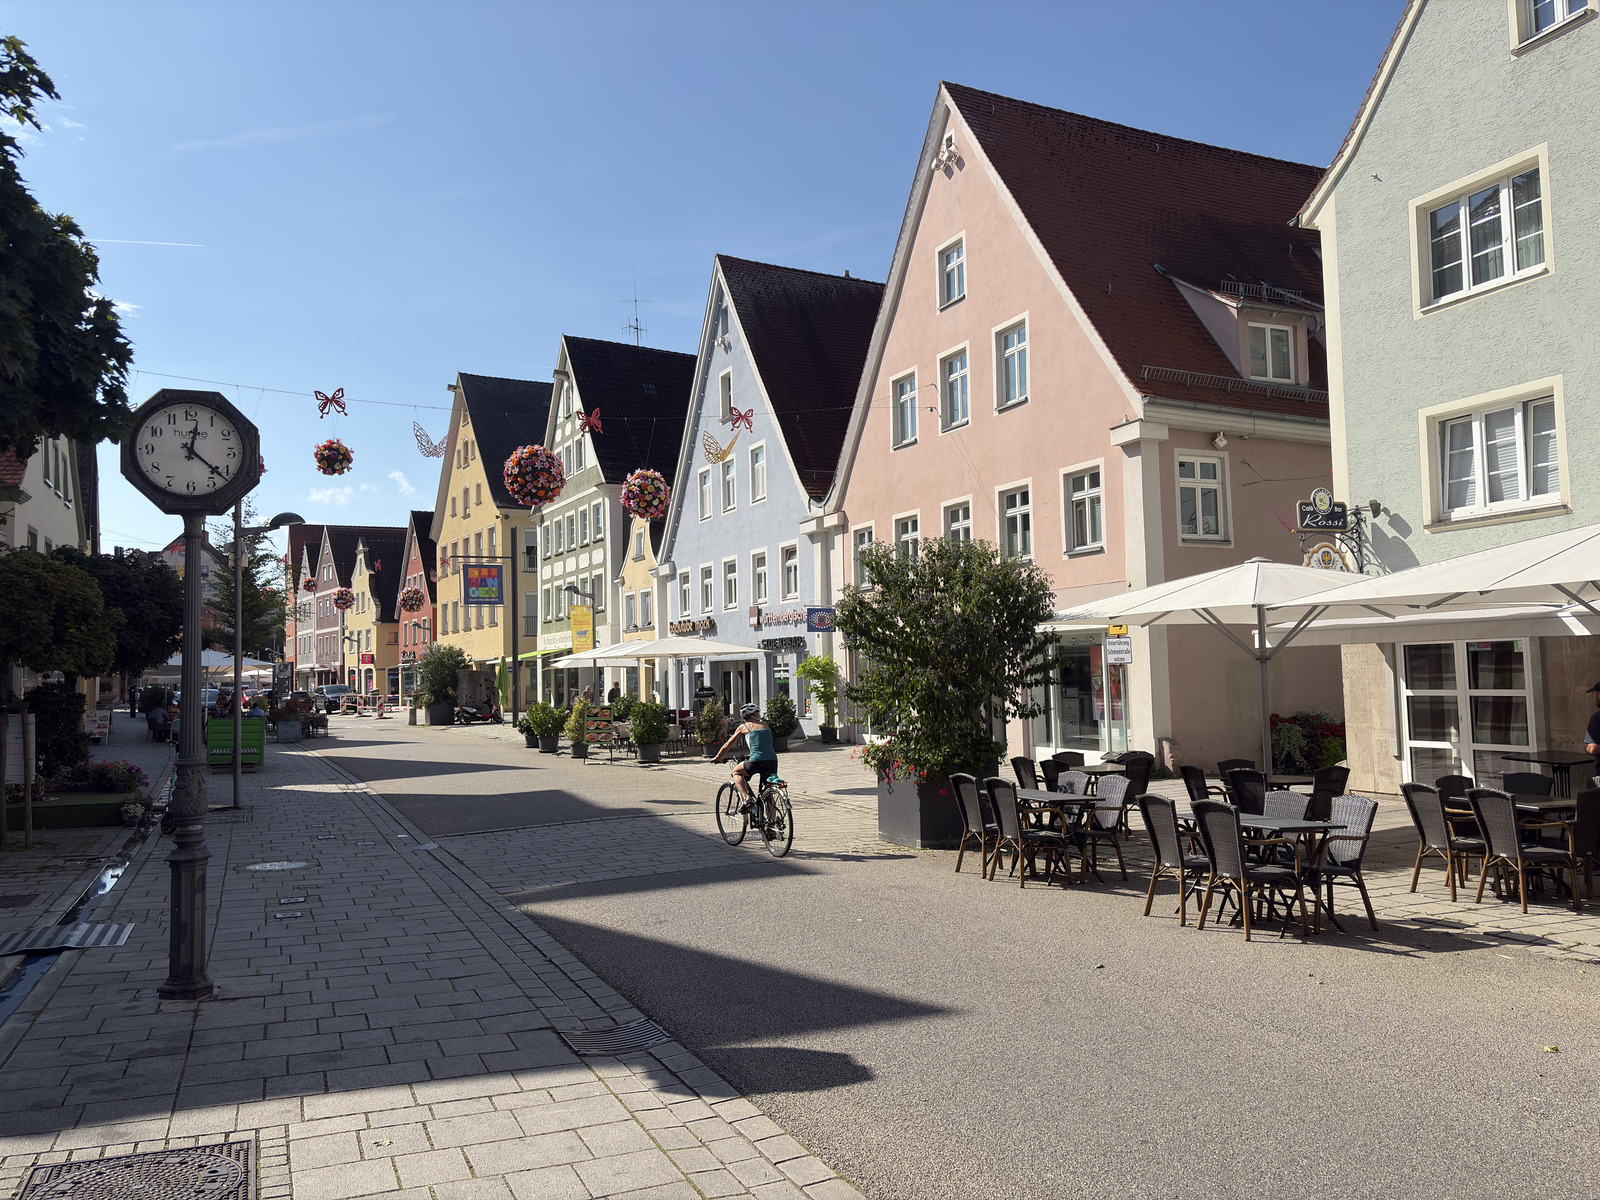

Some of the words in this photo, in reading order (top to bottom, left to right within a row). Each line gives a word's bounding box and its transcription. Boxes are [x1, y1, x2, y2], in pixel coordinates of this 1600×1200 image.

[167, 414, 176, 425] 11
[184, 410, 198, 421] 12
[208, 415, 214, 427] 1
[150, 426, 163, 438] 10
[221, 429, 231, 441] 2
[145, 443, 155, 455] 9
[227, 447, 236, 459] 3
[151, 462, 160, 474] 8
[166, 476, 175, 487] 7
[186, 481, 196, 494] 6
[207, 477, 216, 488] 5
[1302, 513, 1344, 527] Rossi
[469, 587, 498, 597] GEN
